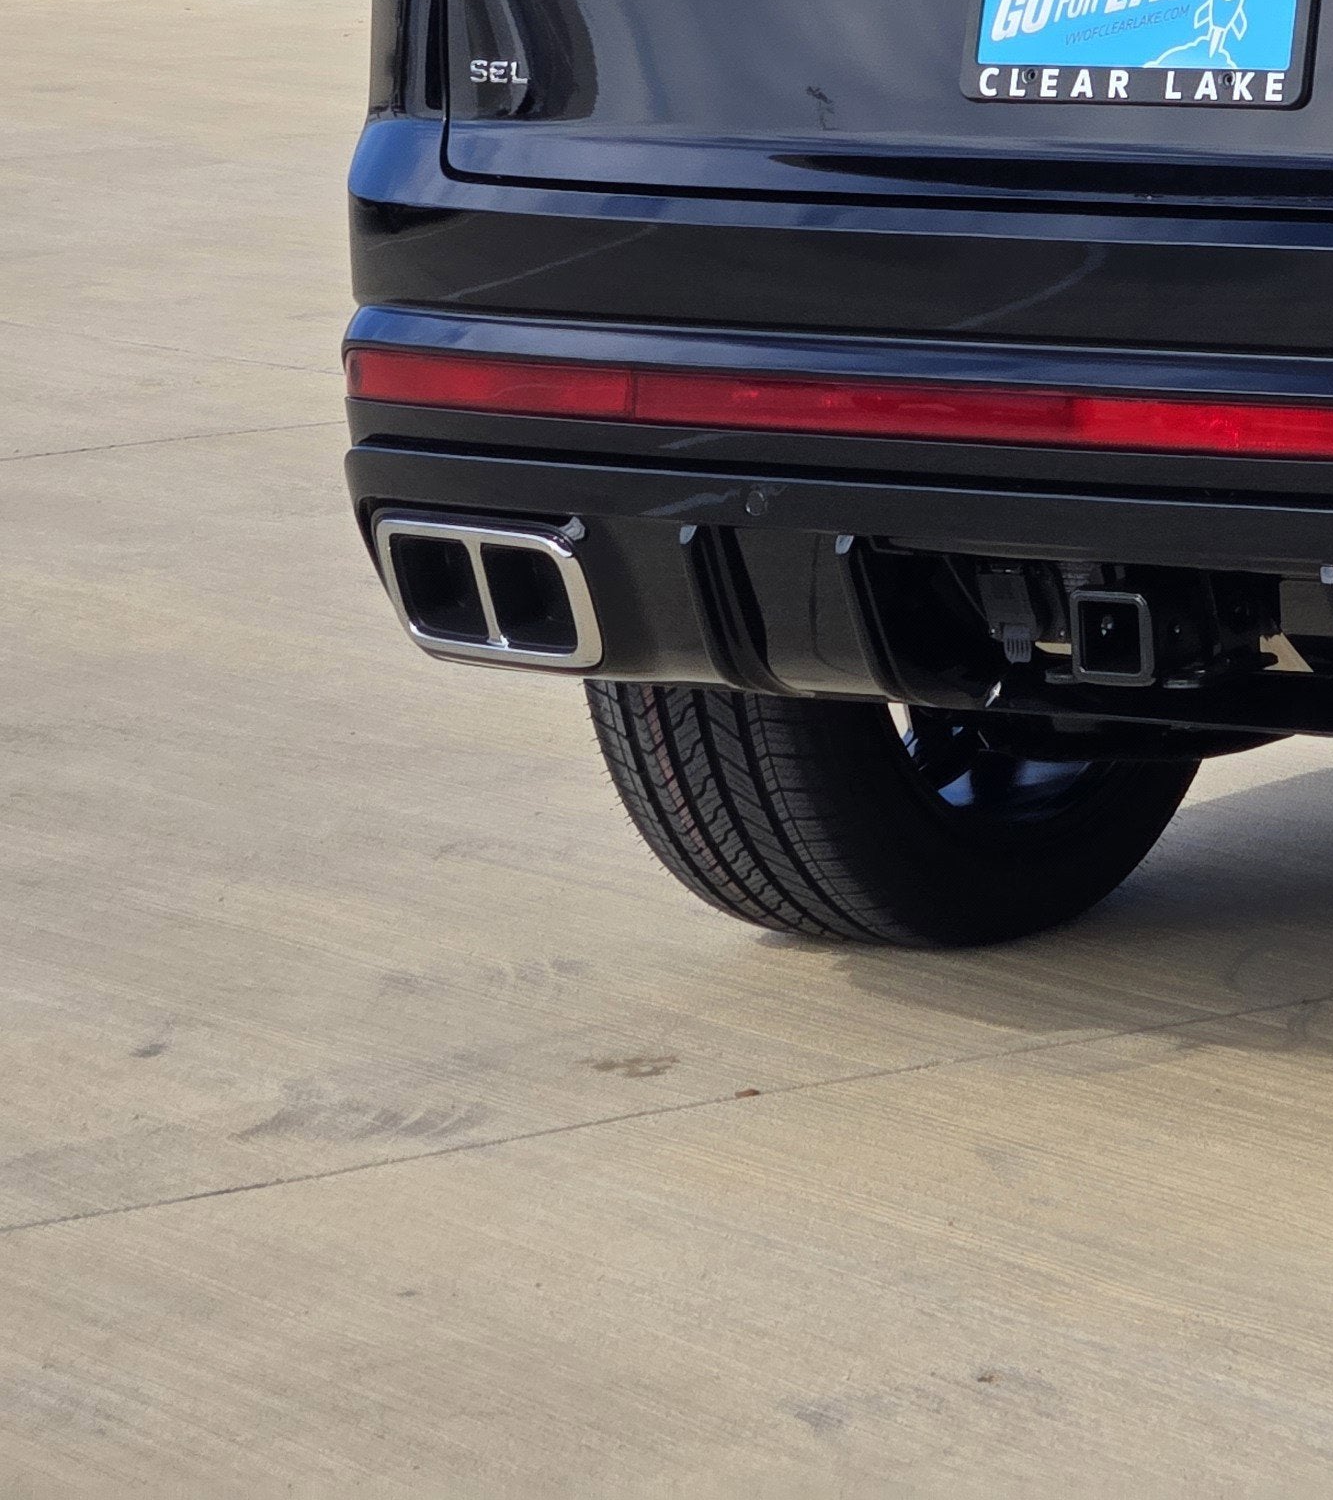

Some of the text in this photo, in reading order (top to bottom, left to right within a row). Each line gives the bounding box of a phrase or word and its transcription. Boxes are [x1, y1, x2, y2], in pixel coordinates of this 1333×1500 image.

[1063, 3, 1191, 46] VWOFCLEARLAKE.COM
[470, 59, 528, 84] SEL
[978, 67, 1286, 102] CLEAR LAKE
